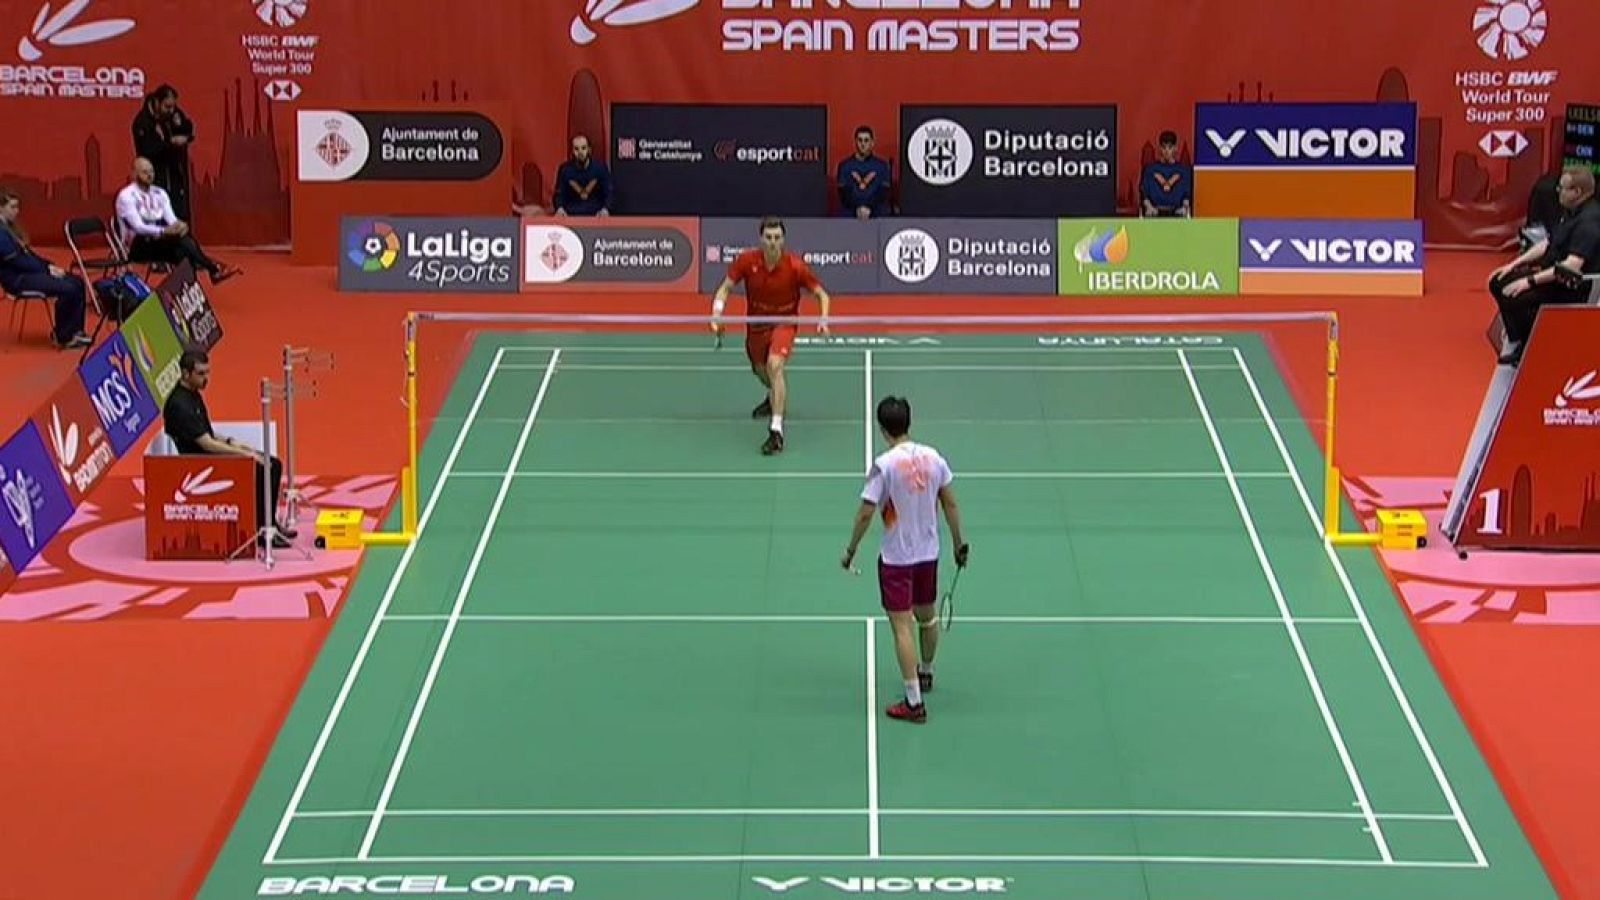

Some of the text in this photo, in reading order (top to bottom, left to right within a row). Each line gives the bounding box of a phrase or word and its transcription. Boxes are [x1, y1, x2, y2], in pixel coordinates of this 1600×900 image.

[722, 19, 1081, 50] SPAIN MASTERS
[248, 48, 315, 60] World Tour
[0, 65, 145, 83] BARCELONA
[252, 62, 312, 76] Super 300
[1455, 71, 1559, 86] HSBC BWF
[58, 84, 144, 98] MASTERS
[1462, 89, 1550, 104] World Tour
[1466, 107, 1545, 124] Super 300
[382, 127, 479, 144] Ajuntament de
[984, 128, 1109, 154] Diputació
[1254, 128, 1407, 158] VICTOR
[382, 143, 479, 162] Barcelona
[654, 150, 702, 162] Catalunya
[984, 156, 1109, 176] Barcelona
[407, 230, 512, 262] LaLiga
[594, 238, 673, 252] Ajuntament de
[948, 237, 1051, 257] Diputació
[1290, 239, 1415, 263] VICTOR
[593, 252, 673, 267] Barcelona
[948, 259, 1051, 276] Barcelona
[408, 260, 510, 287] 4Sports
[1088, 270, 1220, 291] IBERDROLA
[1476, 488, 1503, 534] 1
[257, 875, 575, 895] BARCELONA
[820, 876, 1008, 892] VICTOR
